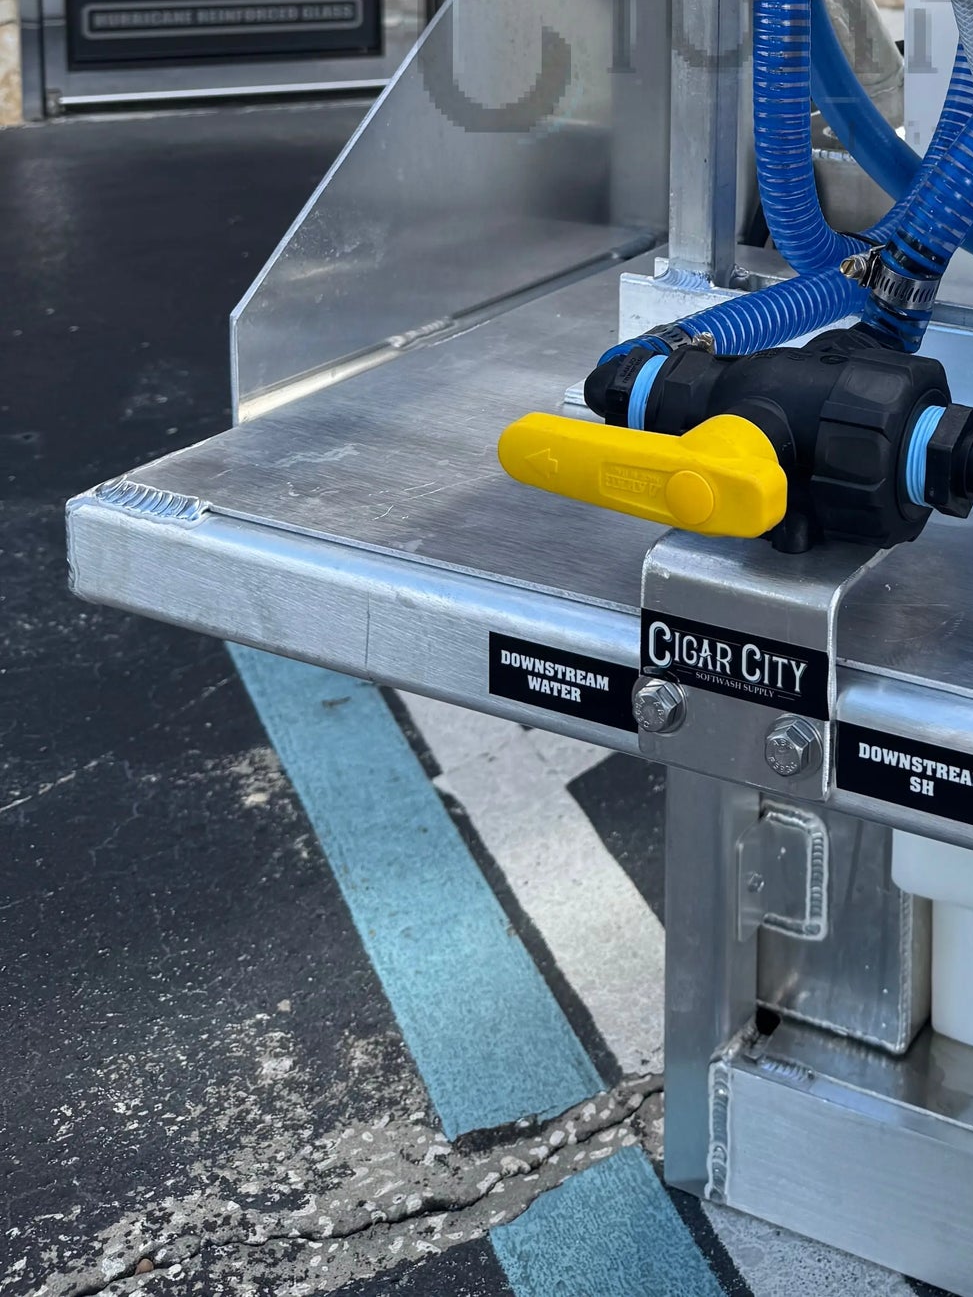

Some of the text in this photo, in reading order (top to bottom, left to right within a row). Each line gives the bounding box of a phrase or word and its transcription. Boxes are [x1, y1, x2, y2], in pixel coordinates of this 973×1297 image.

[92, 9, 193, 29] HURRICANE
[302, 3, 354, 21] GLASS
[500, 649, 609, 692] DOWNSTREAM
[648, 620, 808, 693] CIGAR CITY
[527, 675, 581, 703] WATER
[695, 671, 775, 699] SOFTWASH SUPPLY
[909, 776, 935, 798] SH
